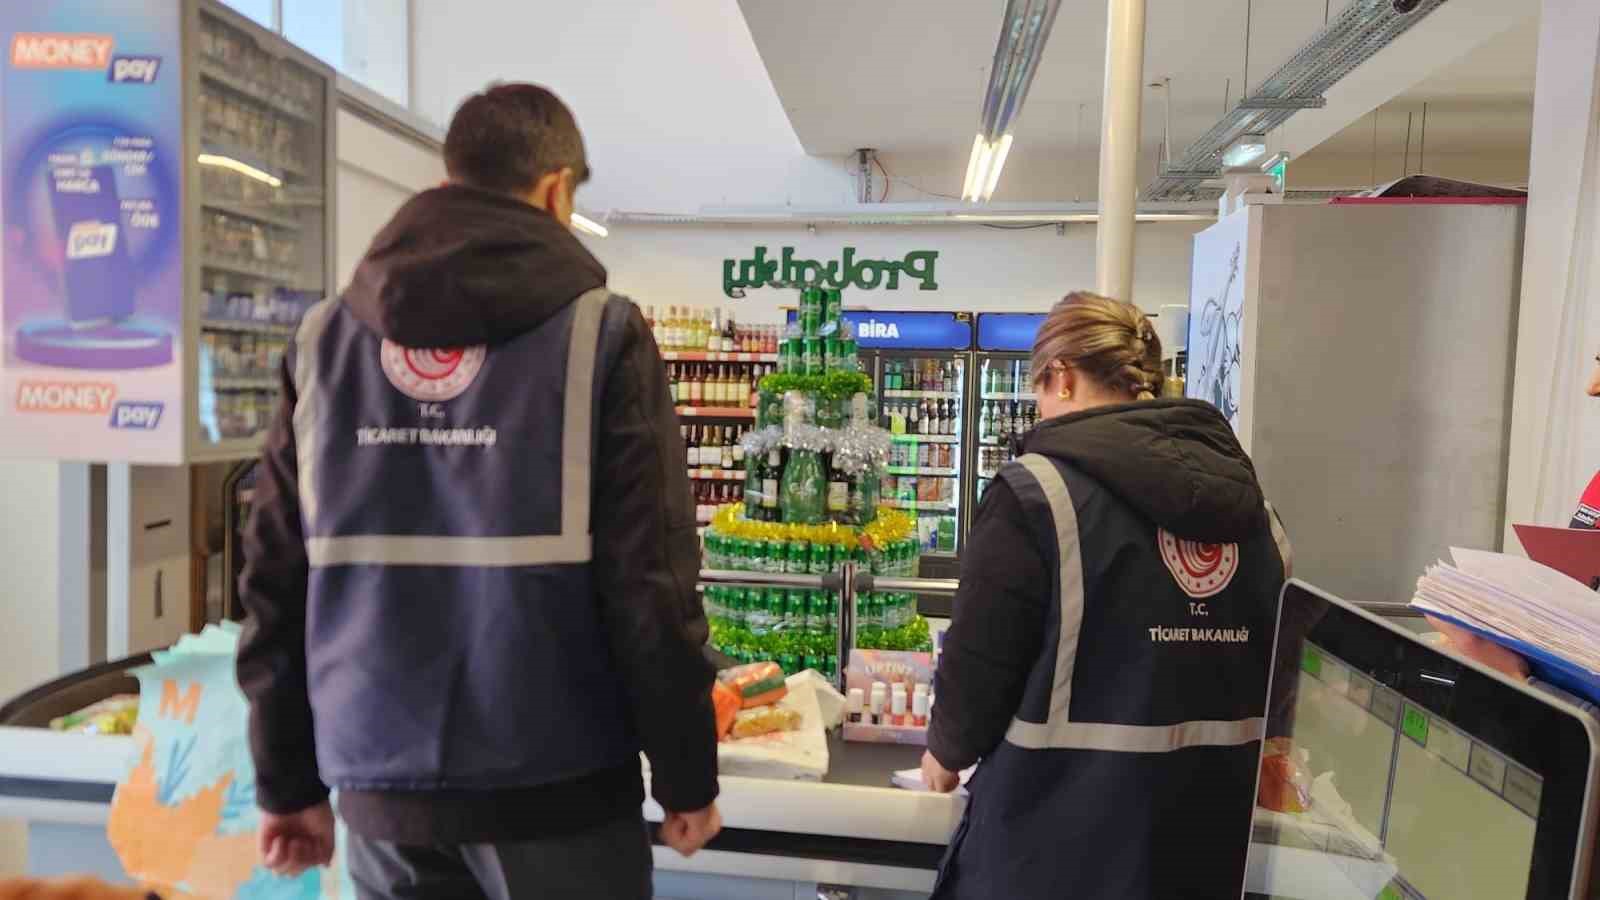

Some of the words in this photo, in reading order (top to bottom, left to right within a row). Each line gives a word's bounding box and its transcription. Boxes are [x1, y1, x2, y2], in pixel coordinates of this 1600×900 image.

[13, 38, 112, 65] MONEY
[113, 59, 157, 82] pay
[858, 319, 899, 339] BİRA
[19, 385, 113, 409] MONEY
[117, 405, 160, 428] pay
[1189, 602, 1209, 616] T.C.
